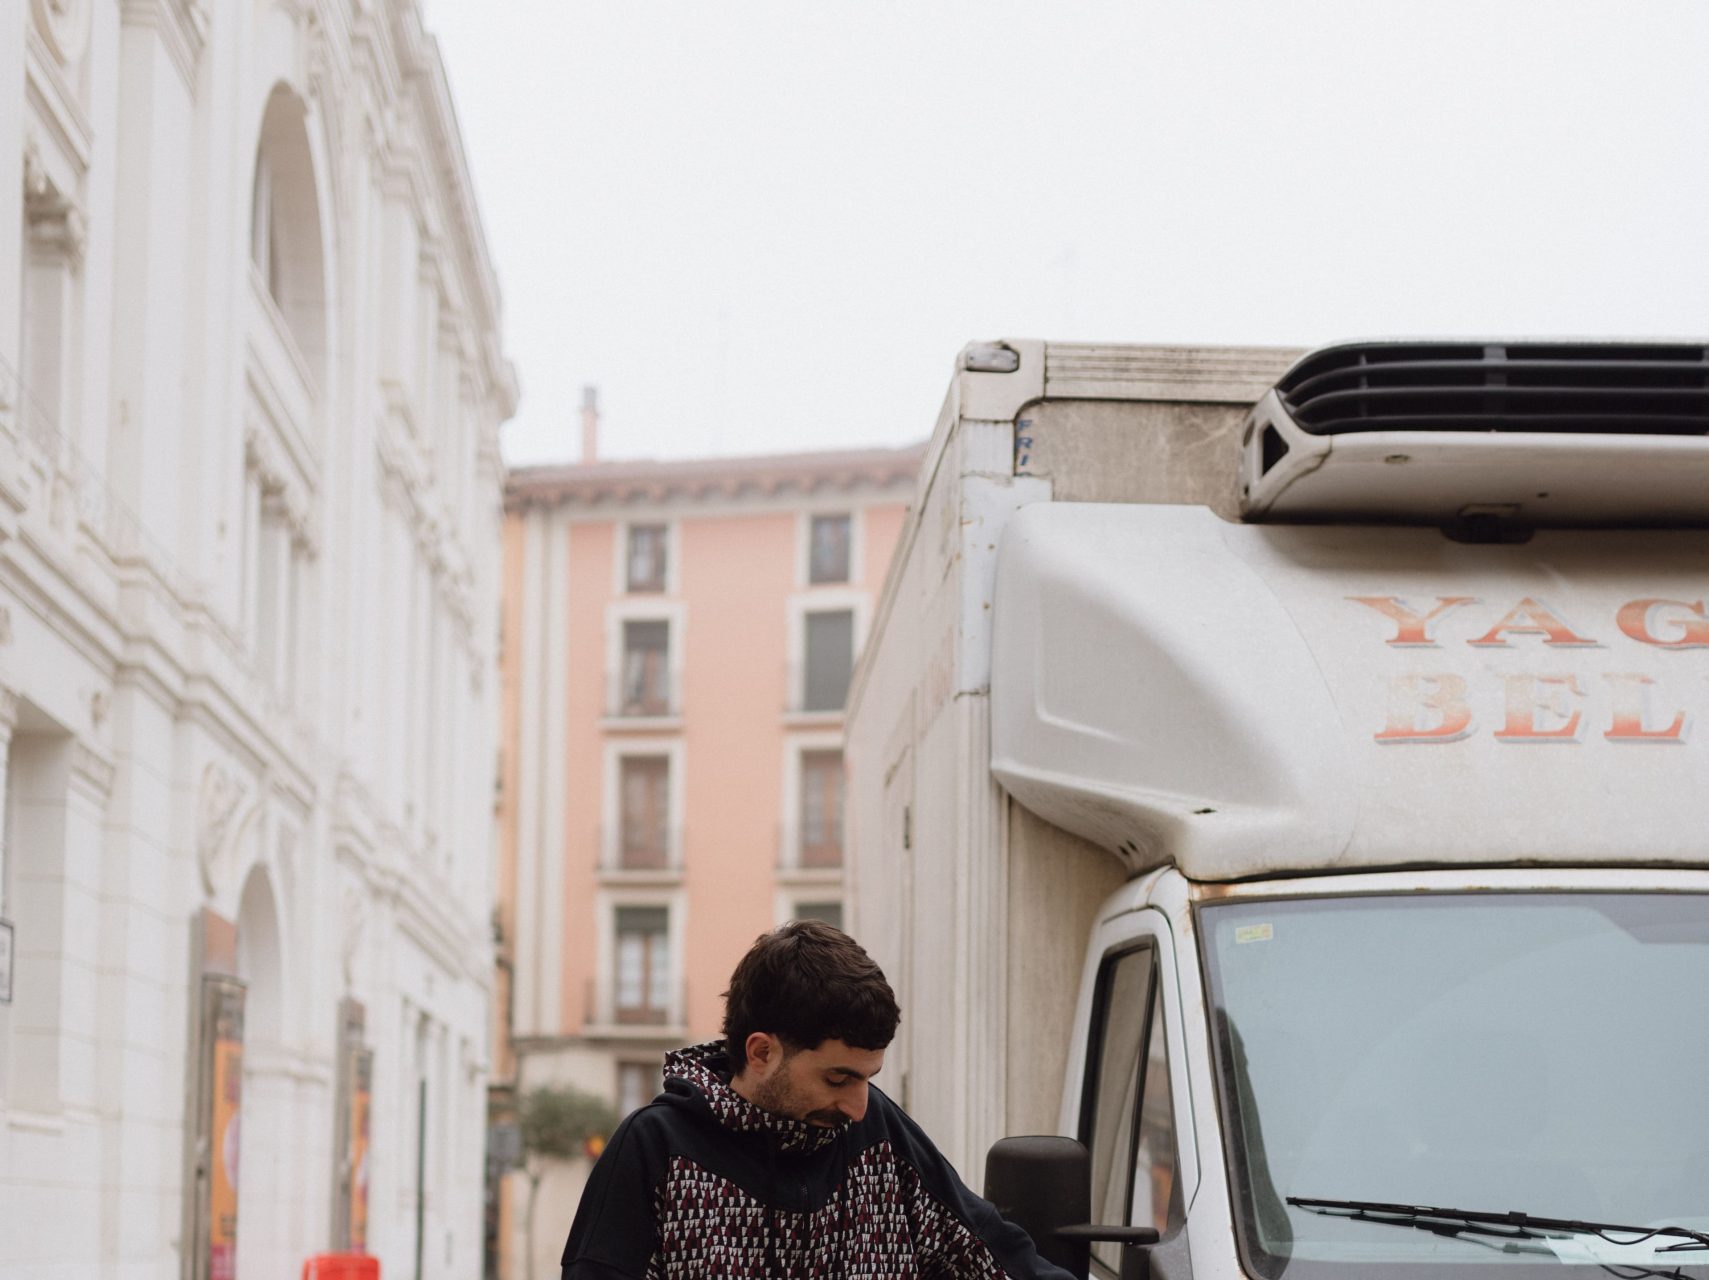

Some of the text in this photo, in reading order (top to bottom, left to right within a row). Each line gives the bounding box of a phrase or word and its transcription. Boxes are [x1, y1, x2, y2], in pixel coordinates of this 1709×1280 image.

[1014, 419, 1034, 477] FRI
[1344, 595, 1709, 649] YAG
[1373, 671, 1692, 745] BEL
